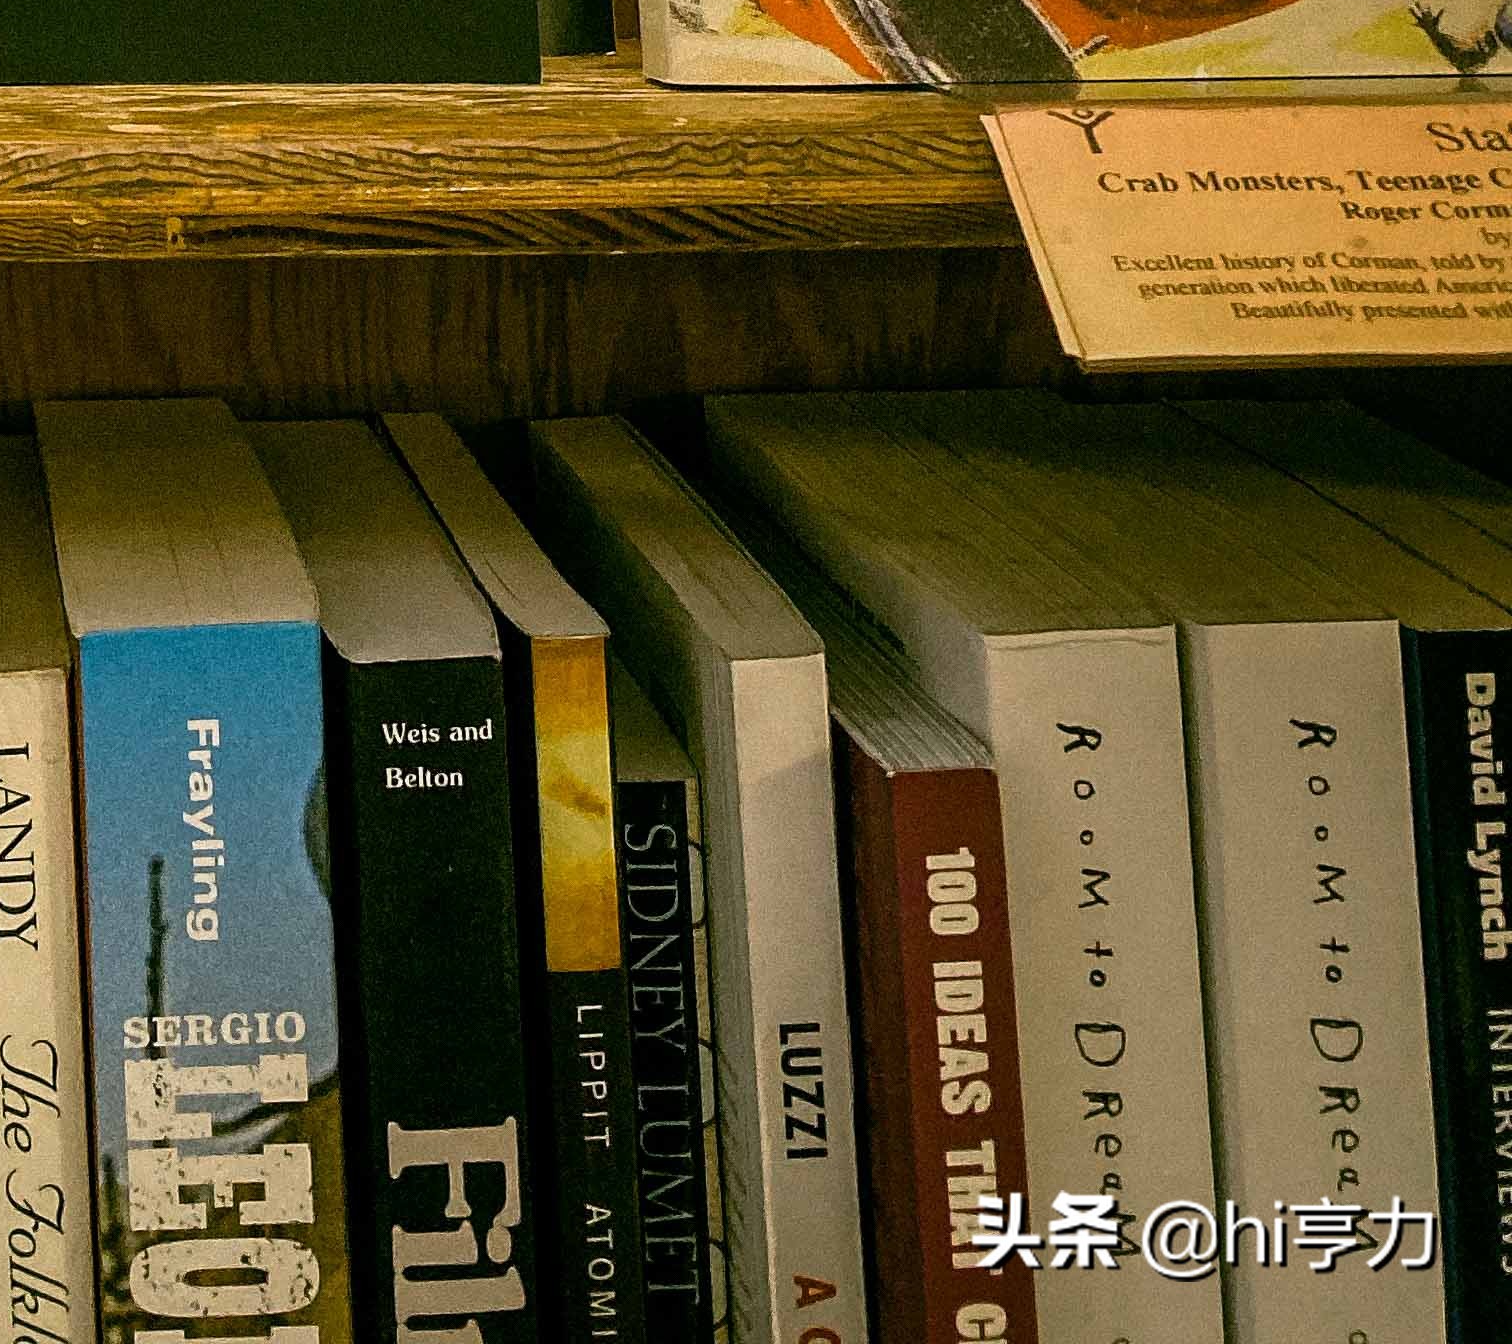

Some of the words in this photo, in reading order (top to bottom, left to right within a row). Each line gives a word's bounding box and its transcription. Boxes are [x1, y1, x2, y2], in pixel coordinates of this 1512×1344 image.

[1425, 121, 1512, 153] Sta
[1097, 170, 1180, 194] Crab
[1188, 168, 1346, 196] Monsters,
[1349, 167, 1481, 196] Teenage
[1340, 199, 1424, 225] Roger
[1112, 253, 1216, 273] Excellent
[1222, 253, 1295, 273] history
[1303, 252, 1329, 269] of
[1138, 278, 1256, 303] generation
[1260, 277, 1326, 295] which
[1230, 301, 1355, 322] Beautifully
[382, 722, 441, 745] Weis
[449, 718, 494, 742] and
[1466, 672, 1507, 807] David
[386, 766, 464, 789] Belton
[182, 717, 227, 942] Frayling
[926, 846, 980, 937] 100
[1466, 820, 1509, 961] Lynch
[625, 822, 688, 1056] SIDNEY
[1084, 940, 1115, 990] to
[1319, 938, 1350, 986] to
[123, 1011, 307, 1049] SERGIO
[933, 960, 993, 1116] IDEAS
[576, 1004, 610, 1148] LIPPIT
[779, 1021, 829, 1160] LUZZI
[637, 1083, 701, 1305] LUMET
[945, 1139, 1006, 1276] THAT
[388, 1116, 527, 1344] Fil
[586, 1203, 616, 1338] ATOMI
[793, 1274, 837, 1310] A
